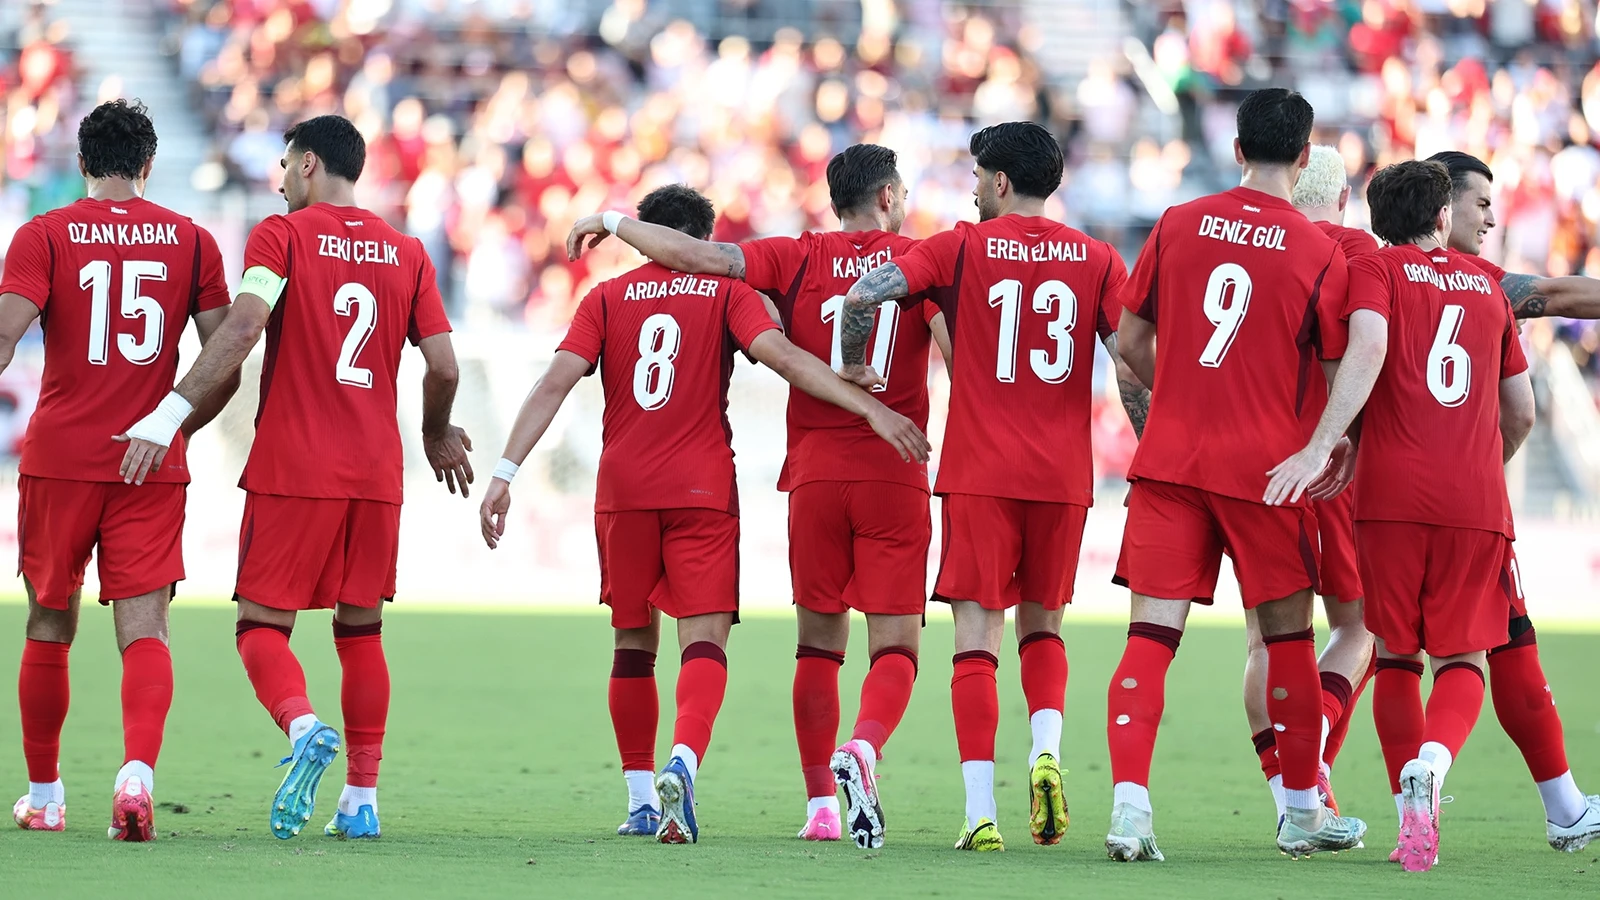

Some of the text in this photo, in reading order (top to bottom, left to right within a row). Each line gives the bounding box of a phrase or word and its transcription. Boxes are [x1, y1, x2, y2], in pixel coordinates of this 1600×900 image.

[68, 222, 179, 246] OZAN KABAK
[317, 234, 400, 267] ZEKİ ÇELİK
[986, 237, 1087, 263] EREN ELMALI
[1198, 214, 1286, 251] DENİZ GÜL
[79, 259, 168, 366] 15
[333, 281, 378, 389] 2
[624, 275, 718, 301] ARDA GÜLER
[988, 278, 1078, 385] 13
[1198, 262, 1253, 369] 9
[632, 313, 681, 411] 8
[1426, 304, 1472, 408] 6
